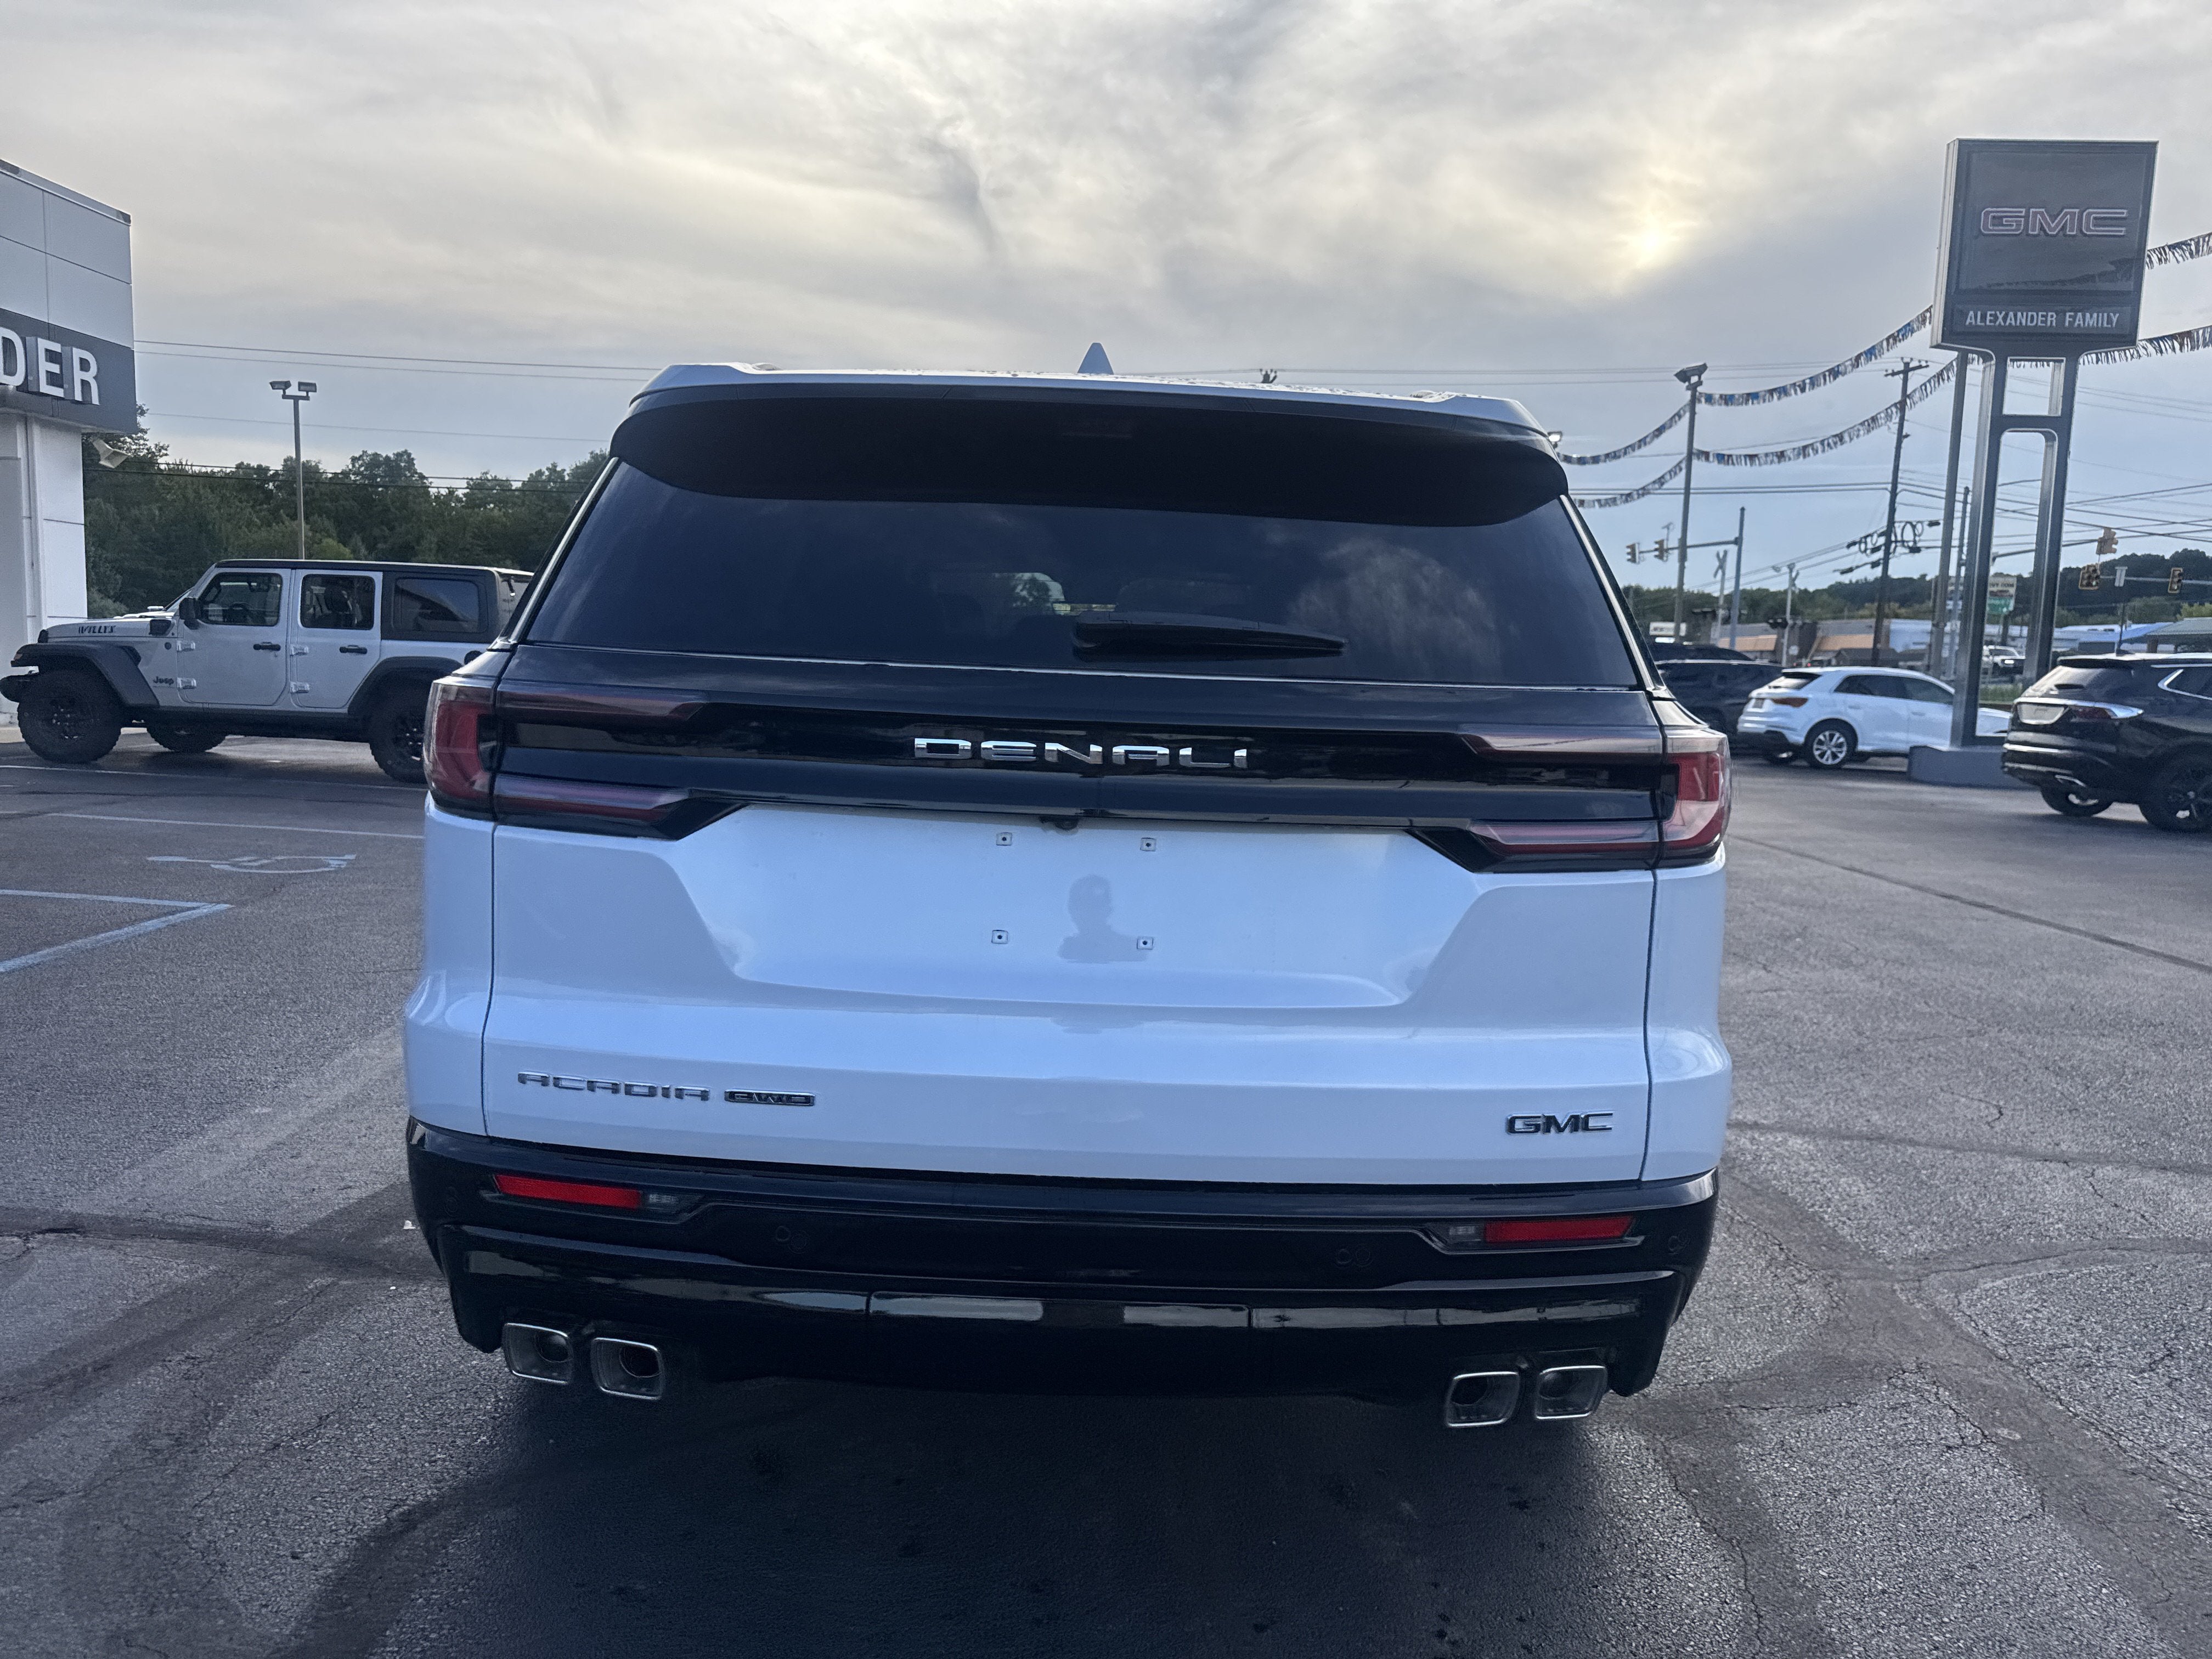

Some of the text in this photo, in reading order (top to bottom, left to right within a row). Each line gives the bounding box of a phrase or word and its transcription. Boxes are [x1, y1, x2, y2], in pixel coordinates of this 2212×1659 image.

[1980, 207, 2128, 236] GMC
[1965, 310, 2119, 328] ALEXANDER FAMILY
[153, 676, 174, 685] Jeep
[914, 737, 1248, 768] DENALI
[517, 1070, 710, 1101] ACADIA
[1506, 1112, 1614, 1135] GMC
